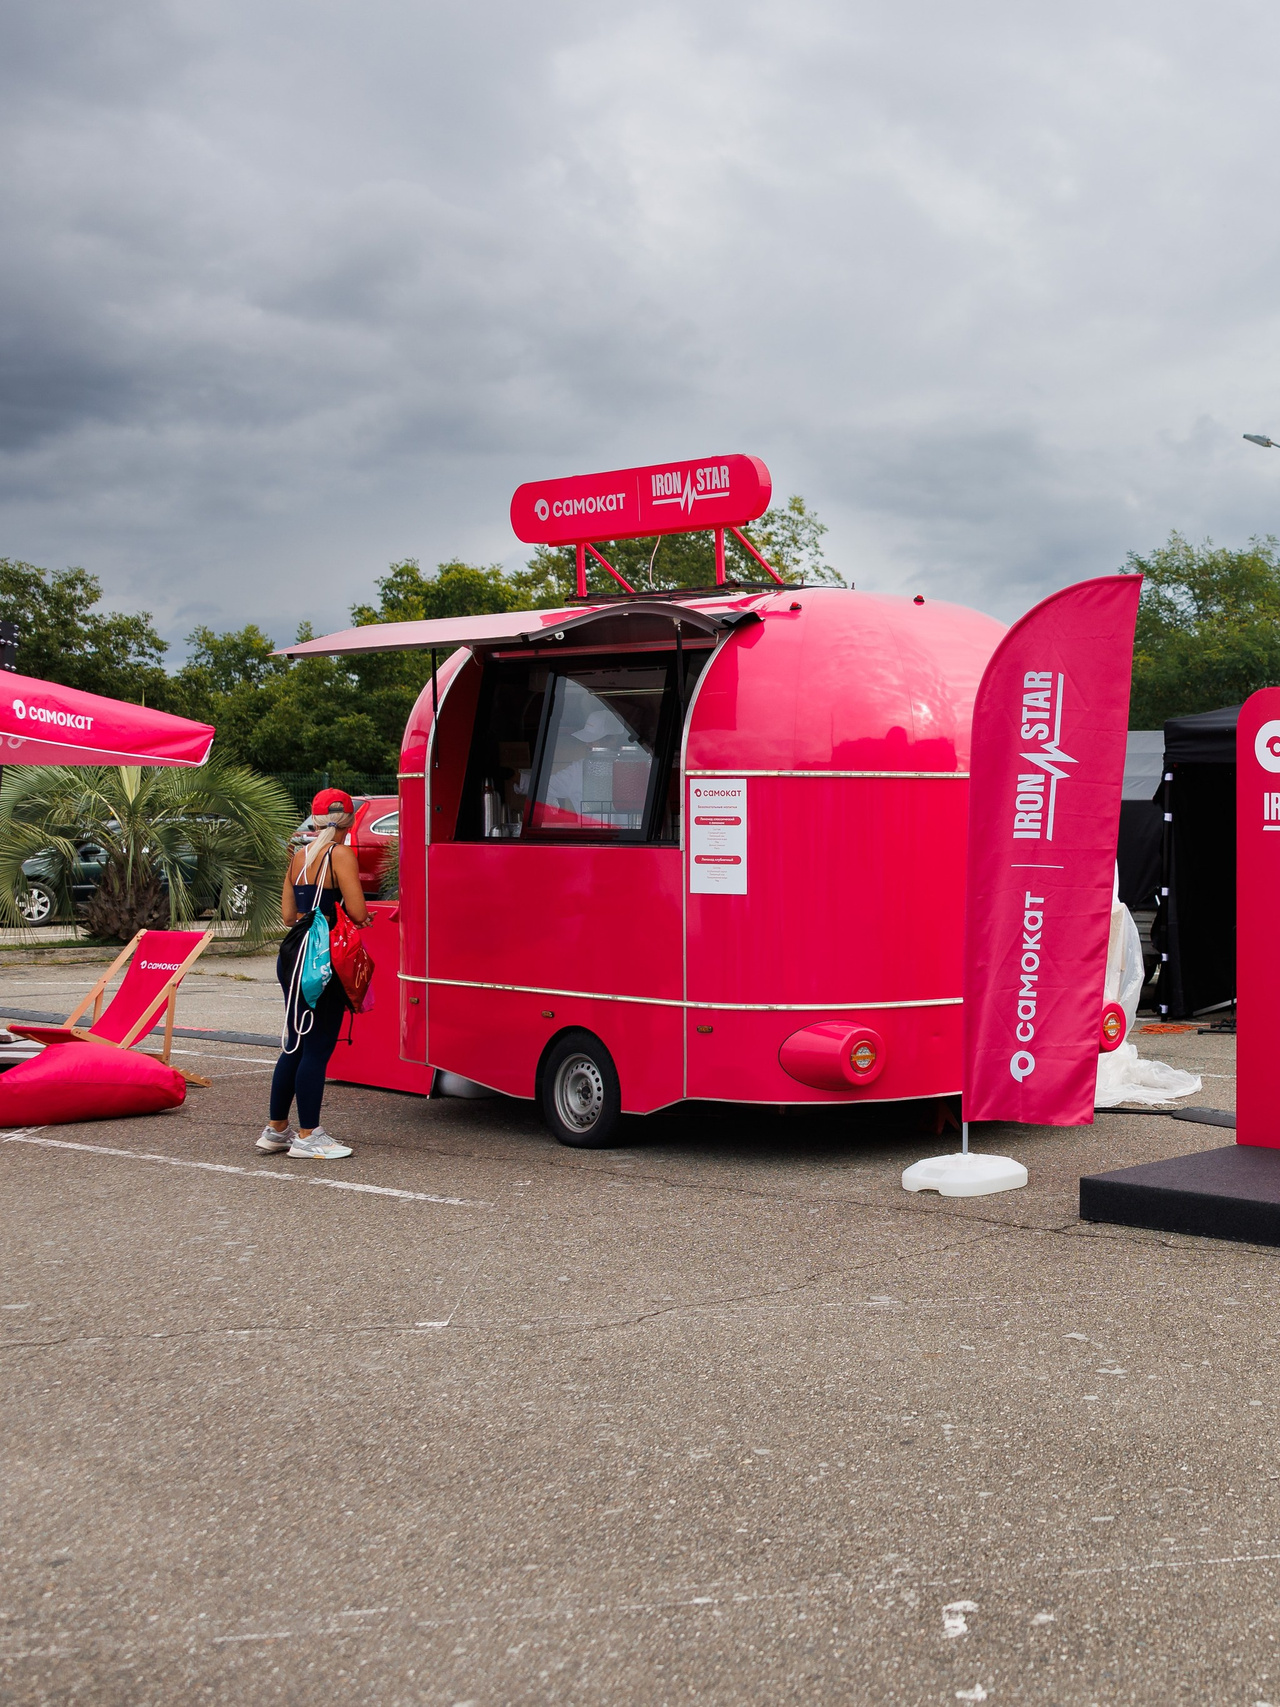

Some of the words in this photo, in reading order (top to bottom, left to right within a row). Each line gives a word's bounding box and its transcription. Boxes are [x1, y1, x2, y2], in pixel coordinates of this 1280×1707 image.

[651, 471, 682, 497] IRON
[695, 465, 730, 491] STAR
[1020, 670, 1053, 740] STAR
[1012, 773, 1046, 840] IRON
